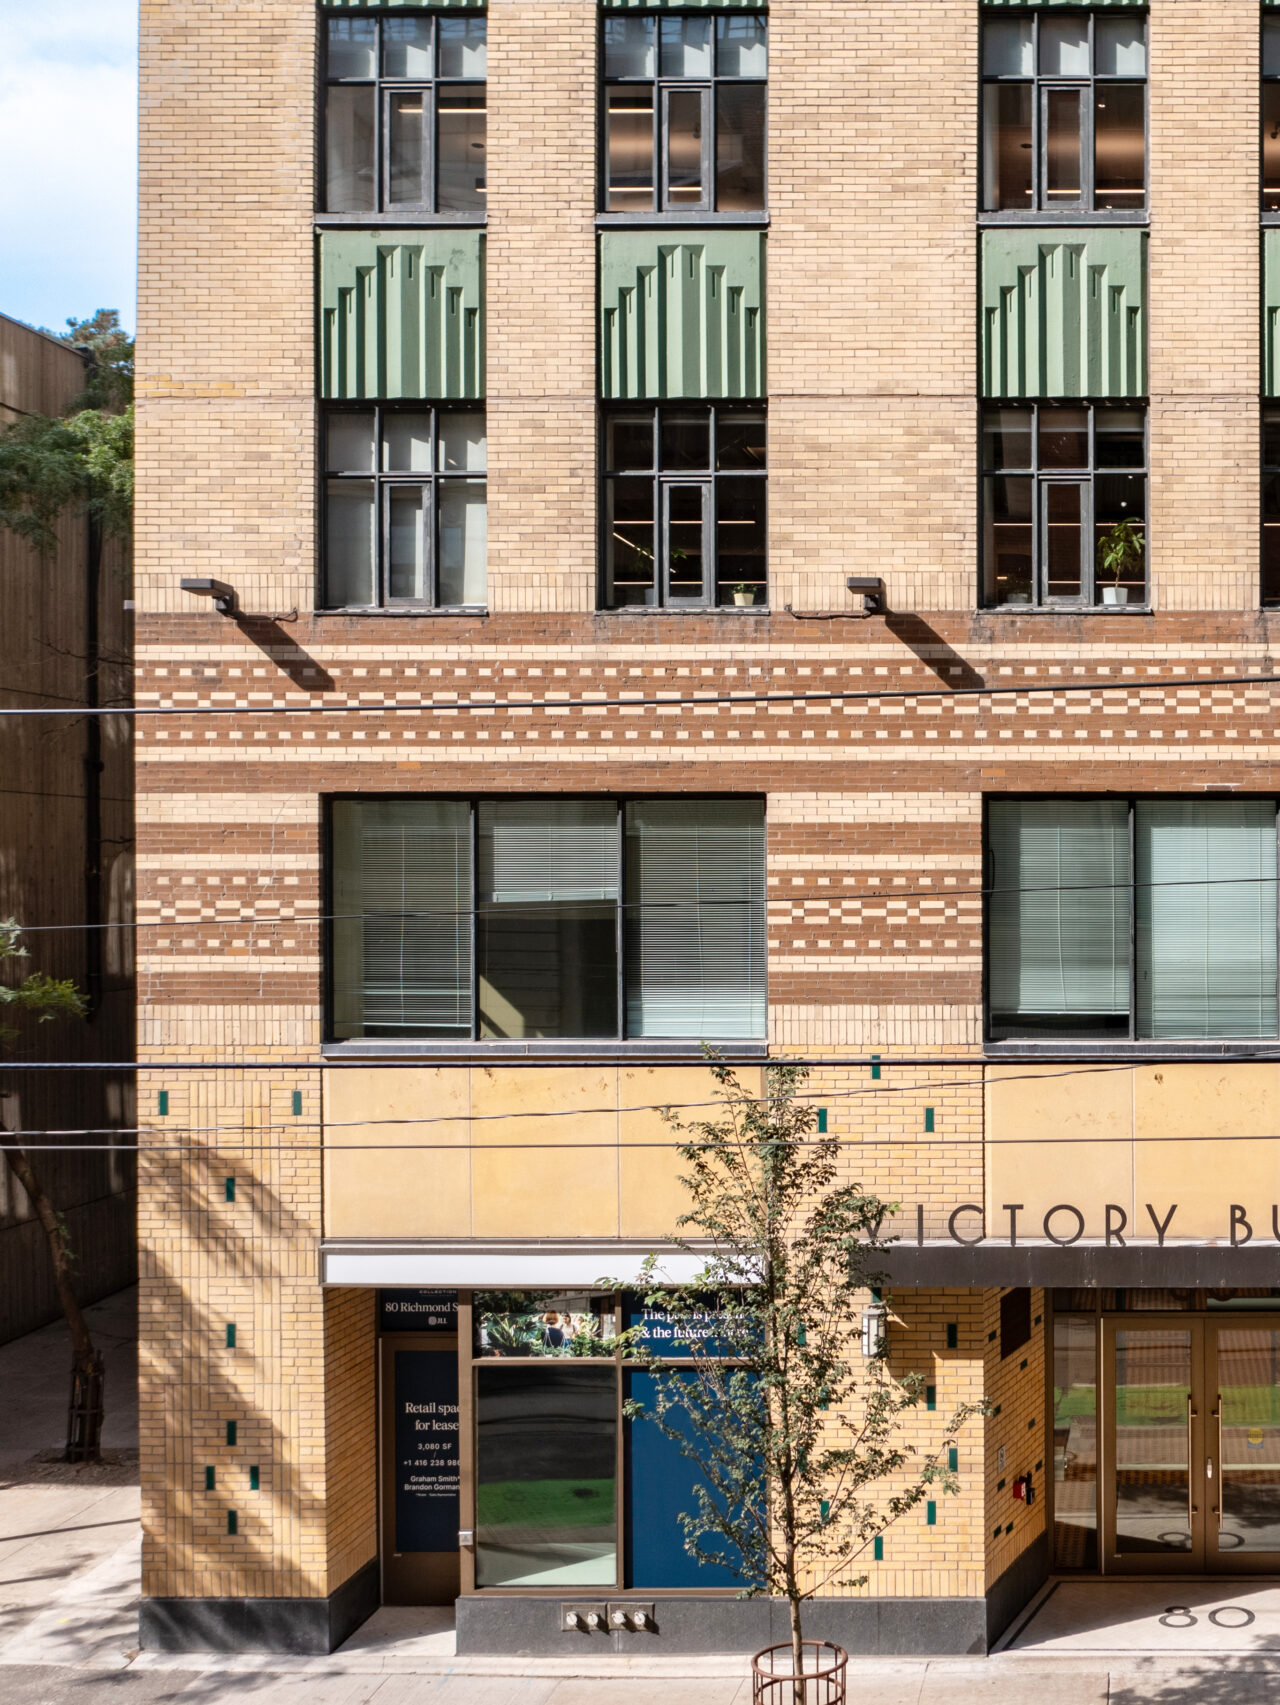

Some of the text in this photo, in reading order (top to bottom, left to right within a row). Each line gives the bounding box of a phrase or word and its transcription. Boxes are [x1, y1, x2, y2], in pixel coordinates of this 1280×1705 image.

[860, 1204, 1178, 1246] VICTORY
[385, 1302, 399, 1312] 80
[400, 1302, 451, 1312] Richmond
[641, 1308, 665, 1320] The
[642, 1326, 651, 1338] &
[653, 1326, 671, 1338] the
[674, 1326, 708, 1338] future
[405, 1402, 436, 1413] Retail
[415, 1419, 459, 1431] for lease
[417, 1443, 440, 1451] 3,080
[1158, 1606, 1256, 1628] 80
